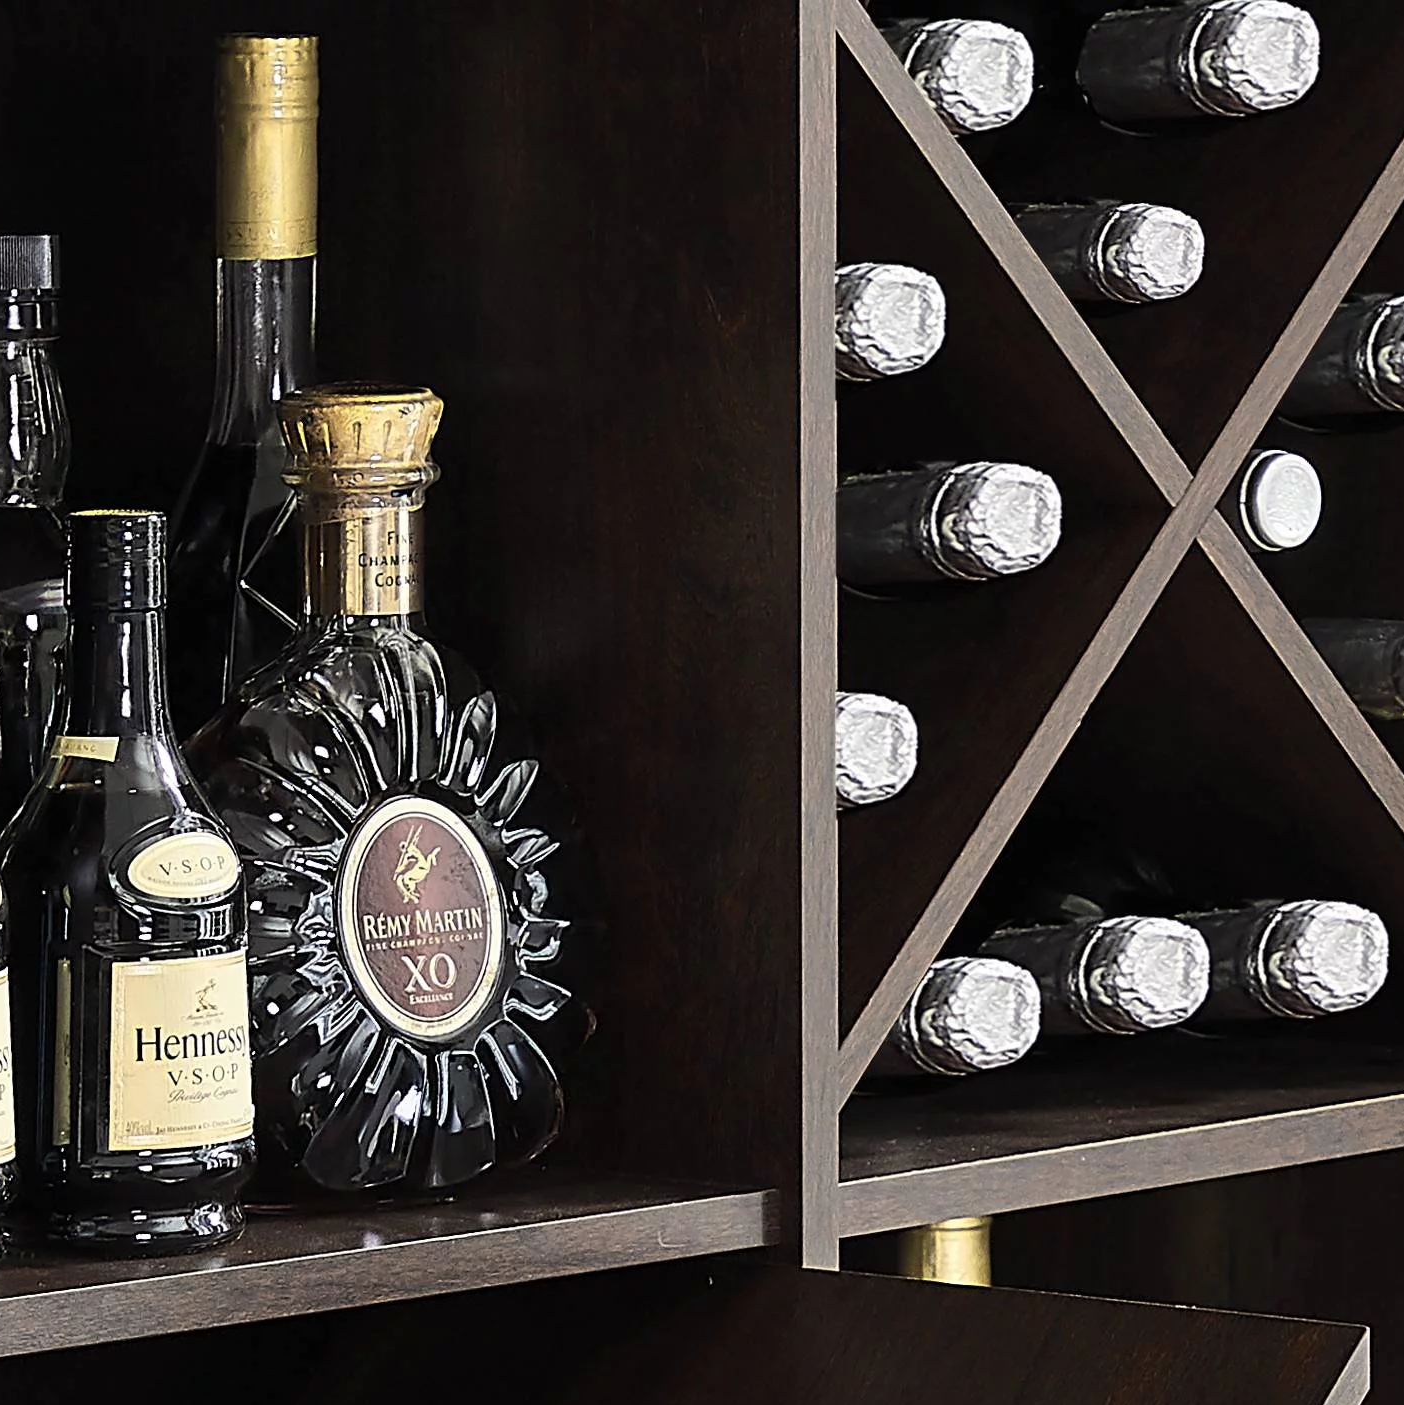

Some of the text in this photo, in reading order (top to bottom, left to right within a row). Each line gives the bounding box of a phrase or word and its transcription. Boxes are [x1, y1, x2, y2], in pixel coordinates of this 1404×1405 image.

[362, 907, 483, 941] RÉMY MARTIN
[401, 953, 457, 993] XO
